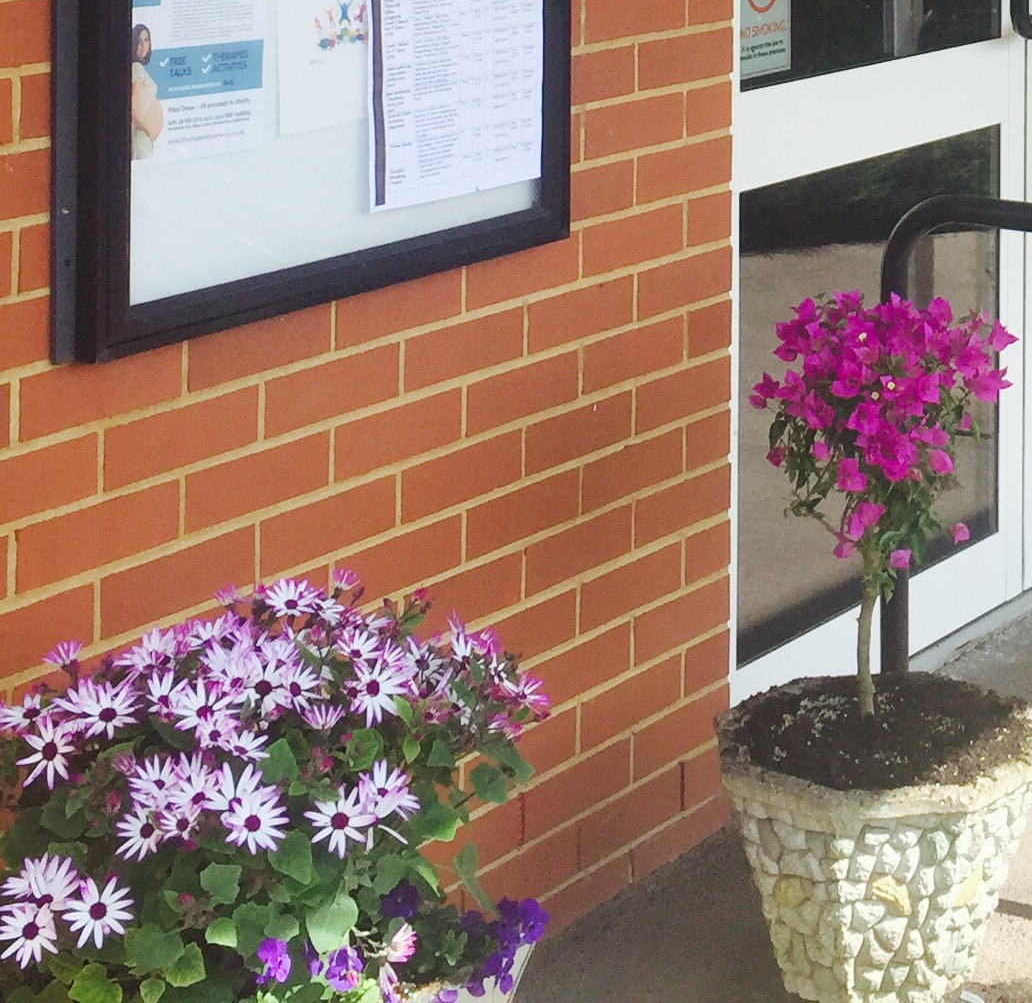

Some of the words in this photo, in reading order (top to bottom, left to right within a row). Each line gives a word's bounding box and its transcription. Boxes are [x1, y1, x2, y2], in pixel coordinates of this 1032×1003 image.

[752, 20, 785, 37] SMOKING
[169, 56, 187, 65] FREE
[212, 49, 249, 61] THERAPIES
[169, 66, 192, 78] TALKS
[211, 61, 248, 73] ACTIVITIES
